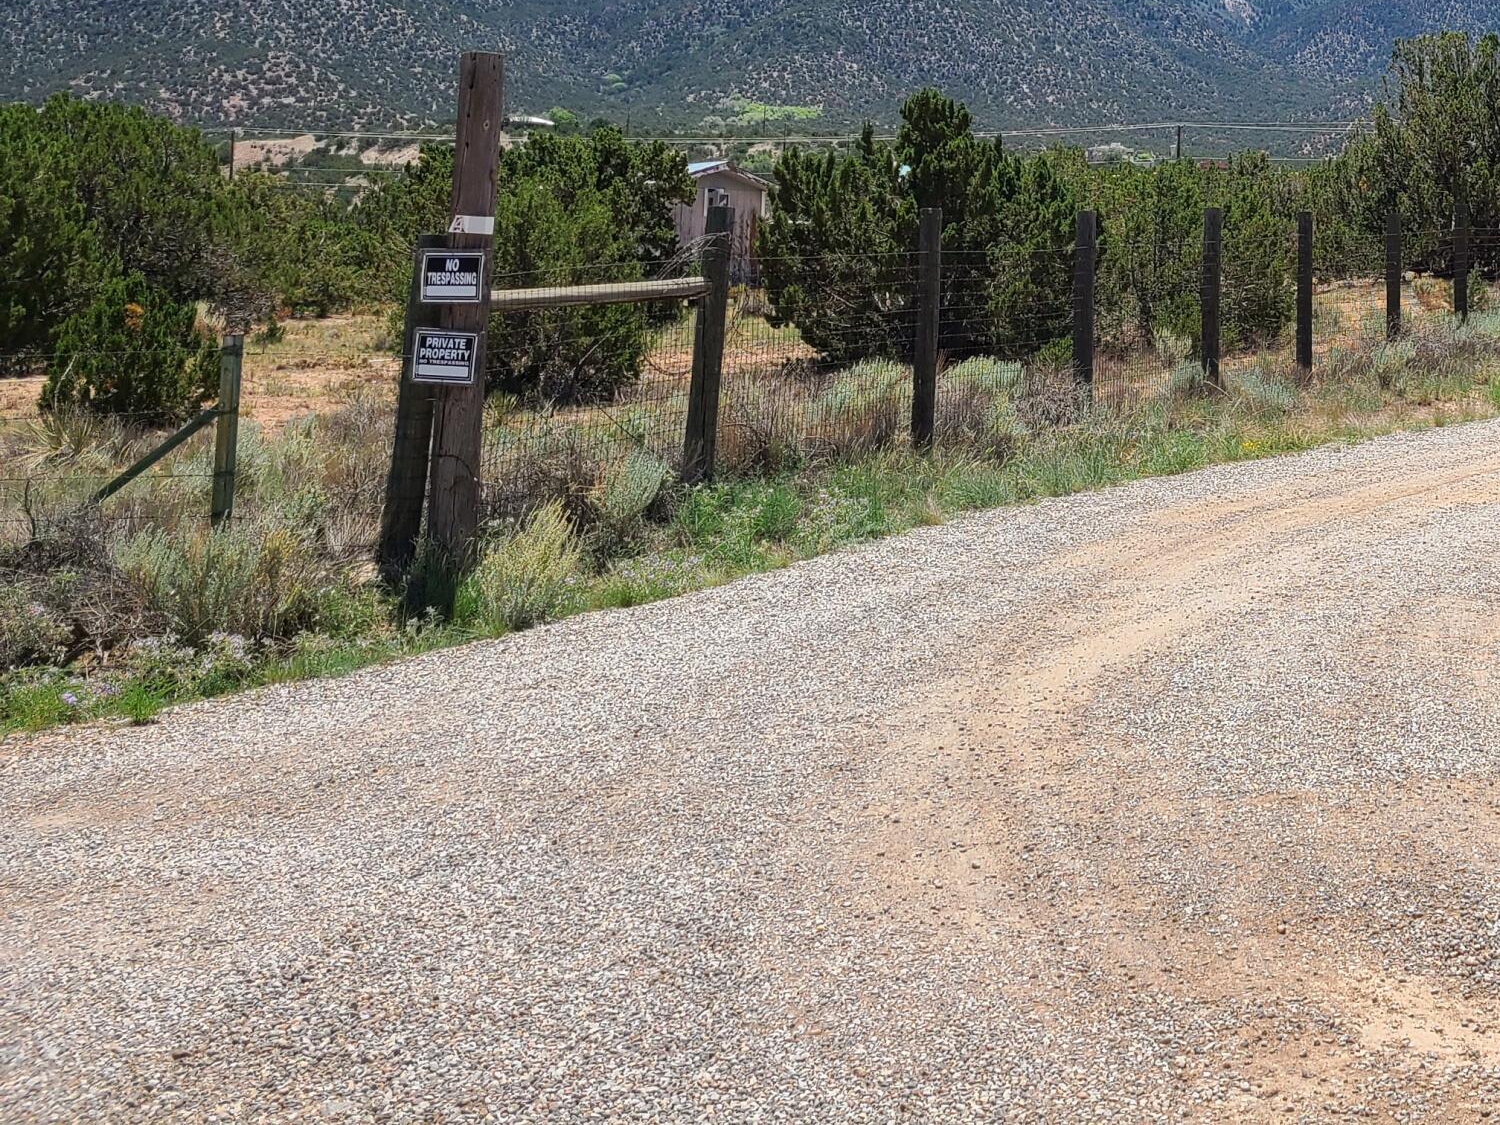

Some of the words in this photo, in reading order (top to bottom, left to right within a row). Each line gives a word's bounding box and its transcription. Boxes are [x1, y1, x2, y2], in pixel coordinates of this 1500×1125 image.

[445, 259, 460, 271] NO
[427, 272, 477, 285] TRESPASSING
[426, 337, 467, 349] PRIVATE
[420, 348, 470, 360] PROPERTY
